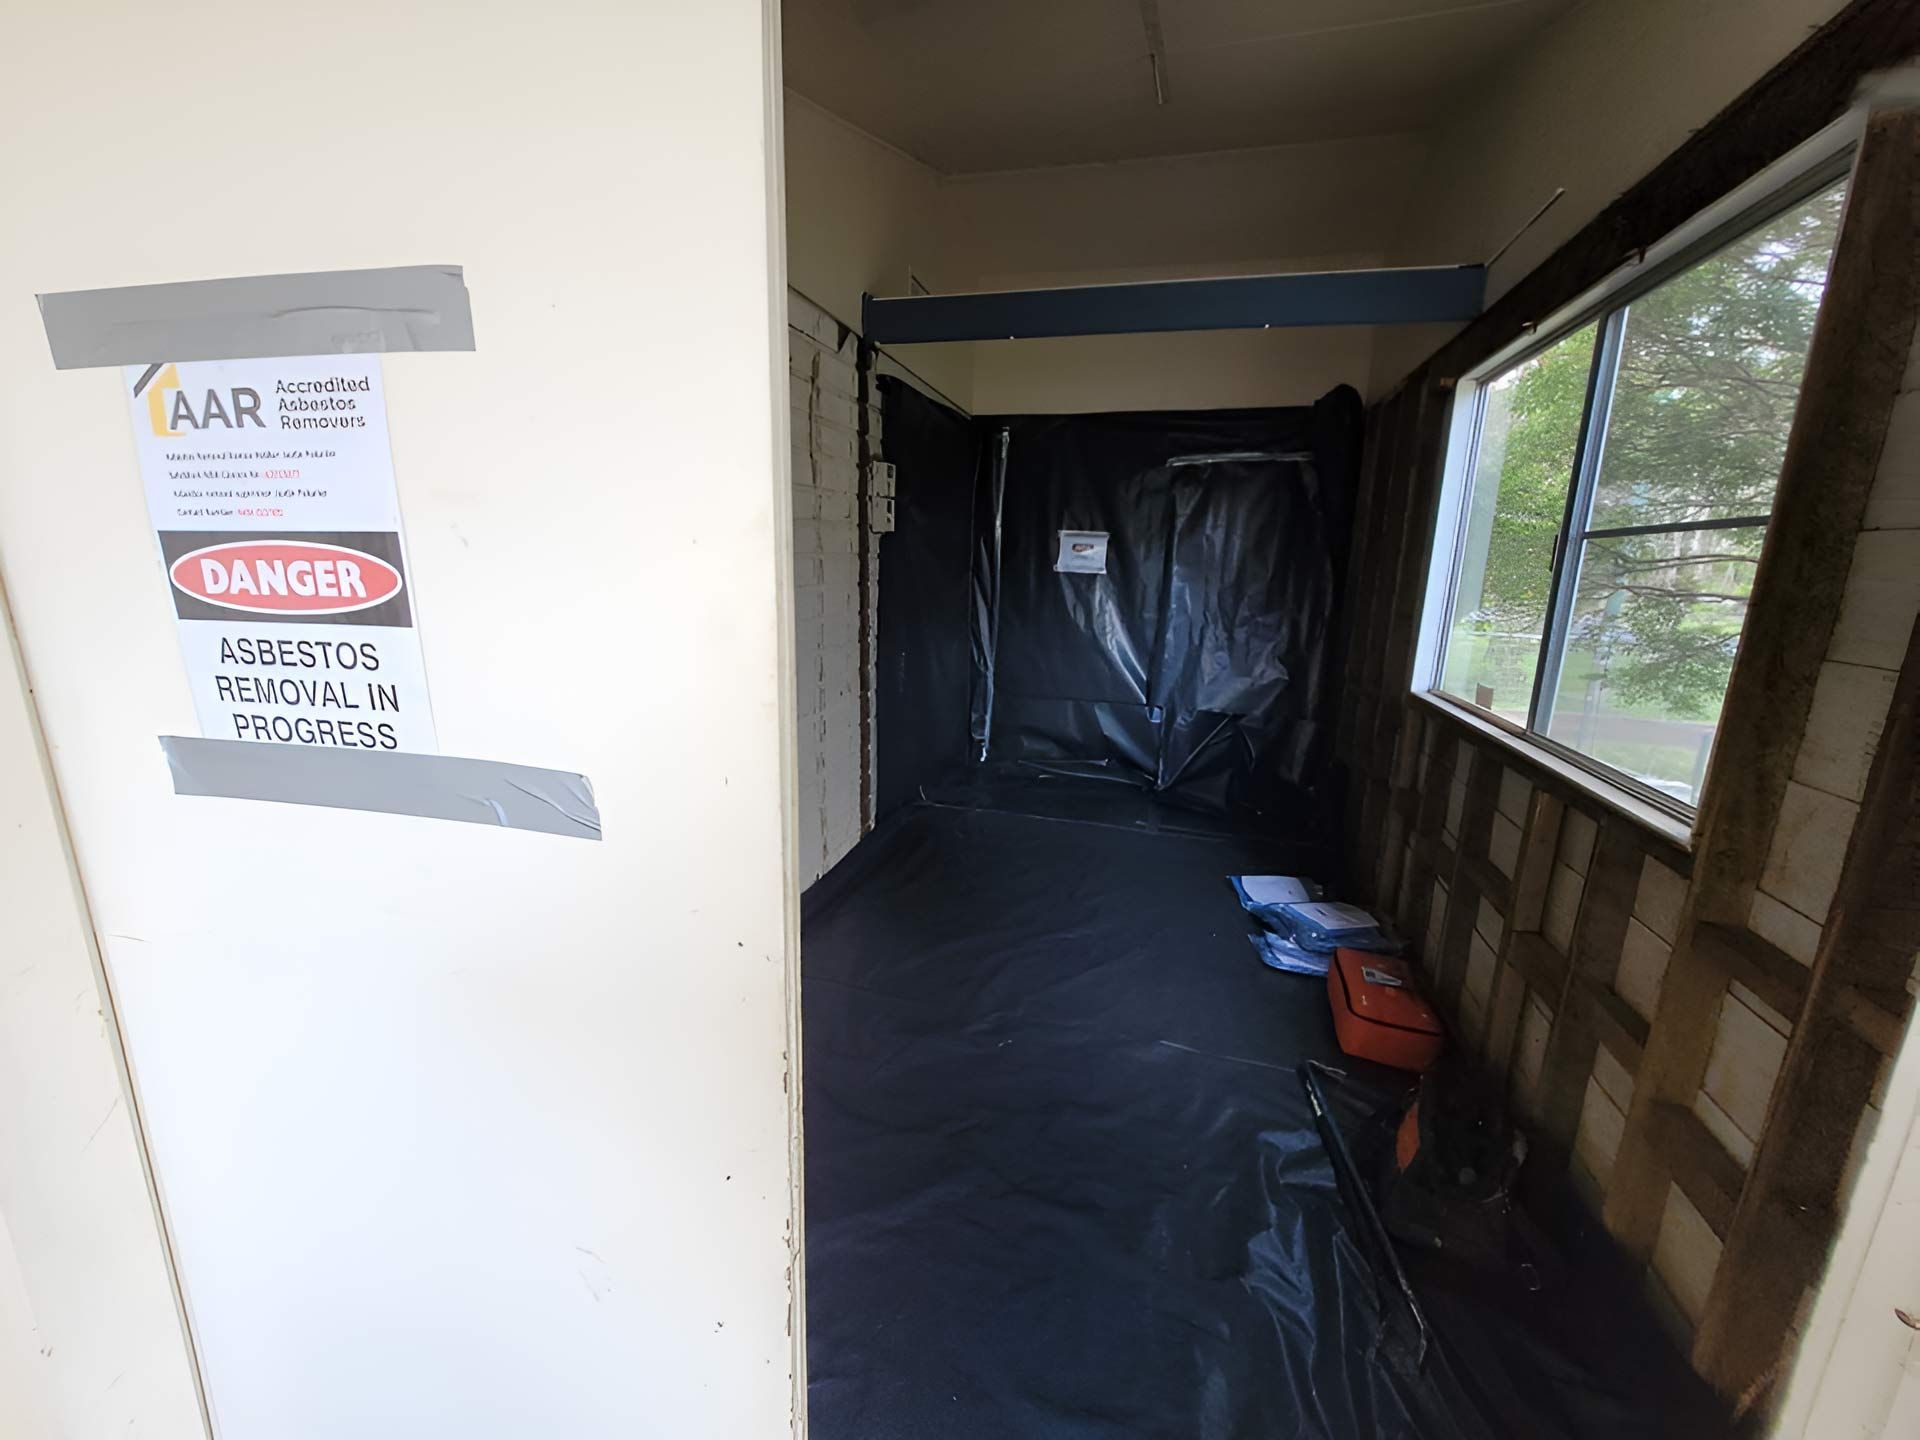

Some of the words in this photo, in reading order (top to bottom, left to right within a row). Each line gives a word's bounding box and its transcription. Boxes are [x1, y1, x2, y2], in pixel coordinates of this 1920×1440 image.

[275, 376, 370, 394] Accredited
[170, 387, 266, 430] AAR
[278, 397, 356, 412] Asbestos
[280, 415, 366, 430] Removers
[200, 558, 366, 597] DANGER
[220, 637, 379, 670] ASBESTOS
[215, 675, 359, 709] REMOVAL
[368, 683, 400, 713] IN
[232, 713, 398, 750] PROGRESS
